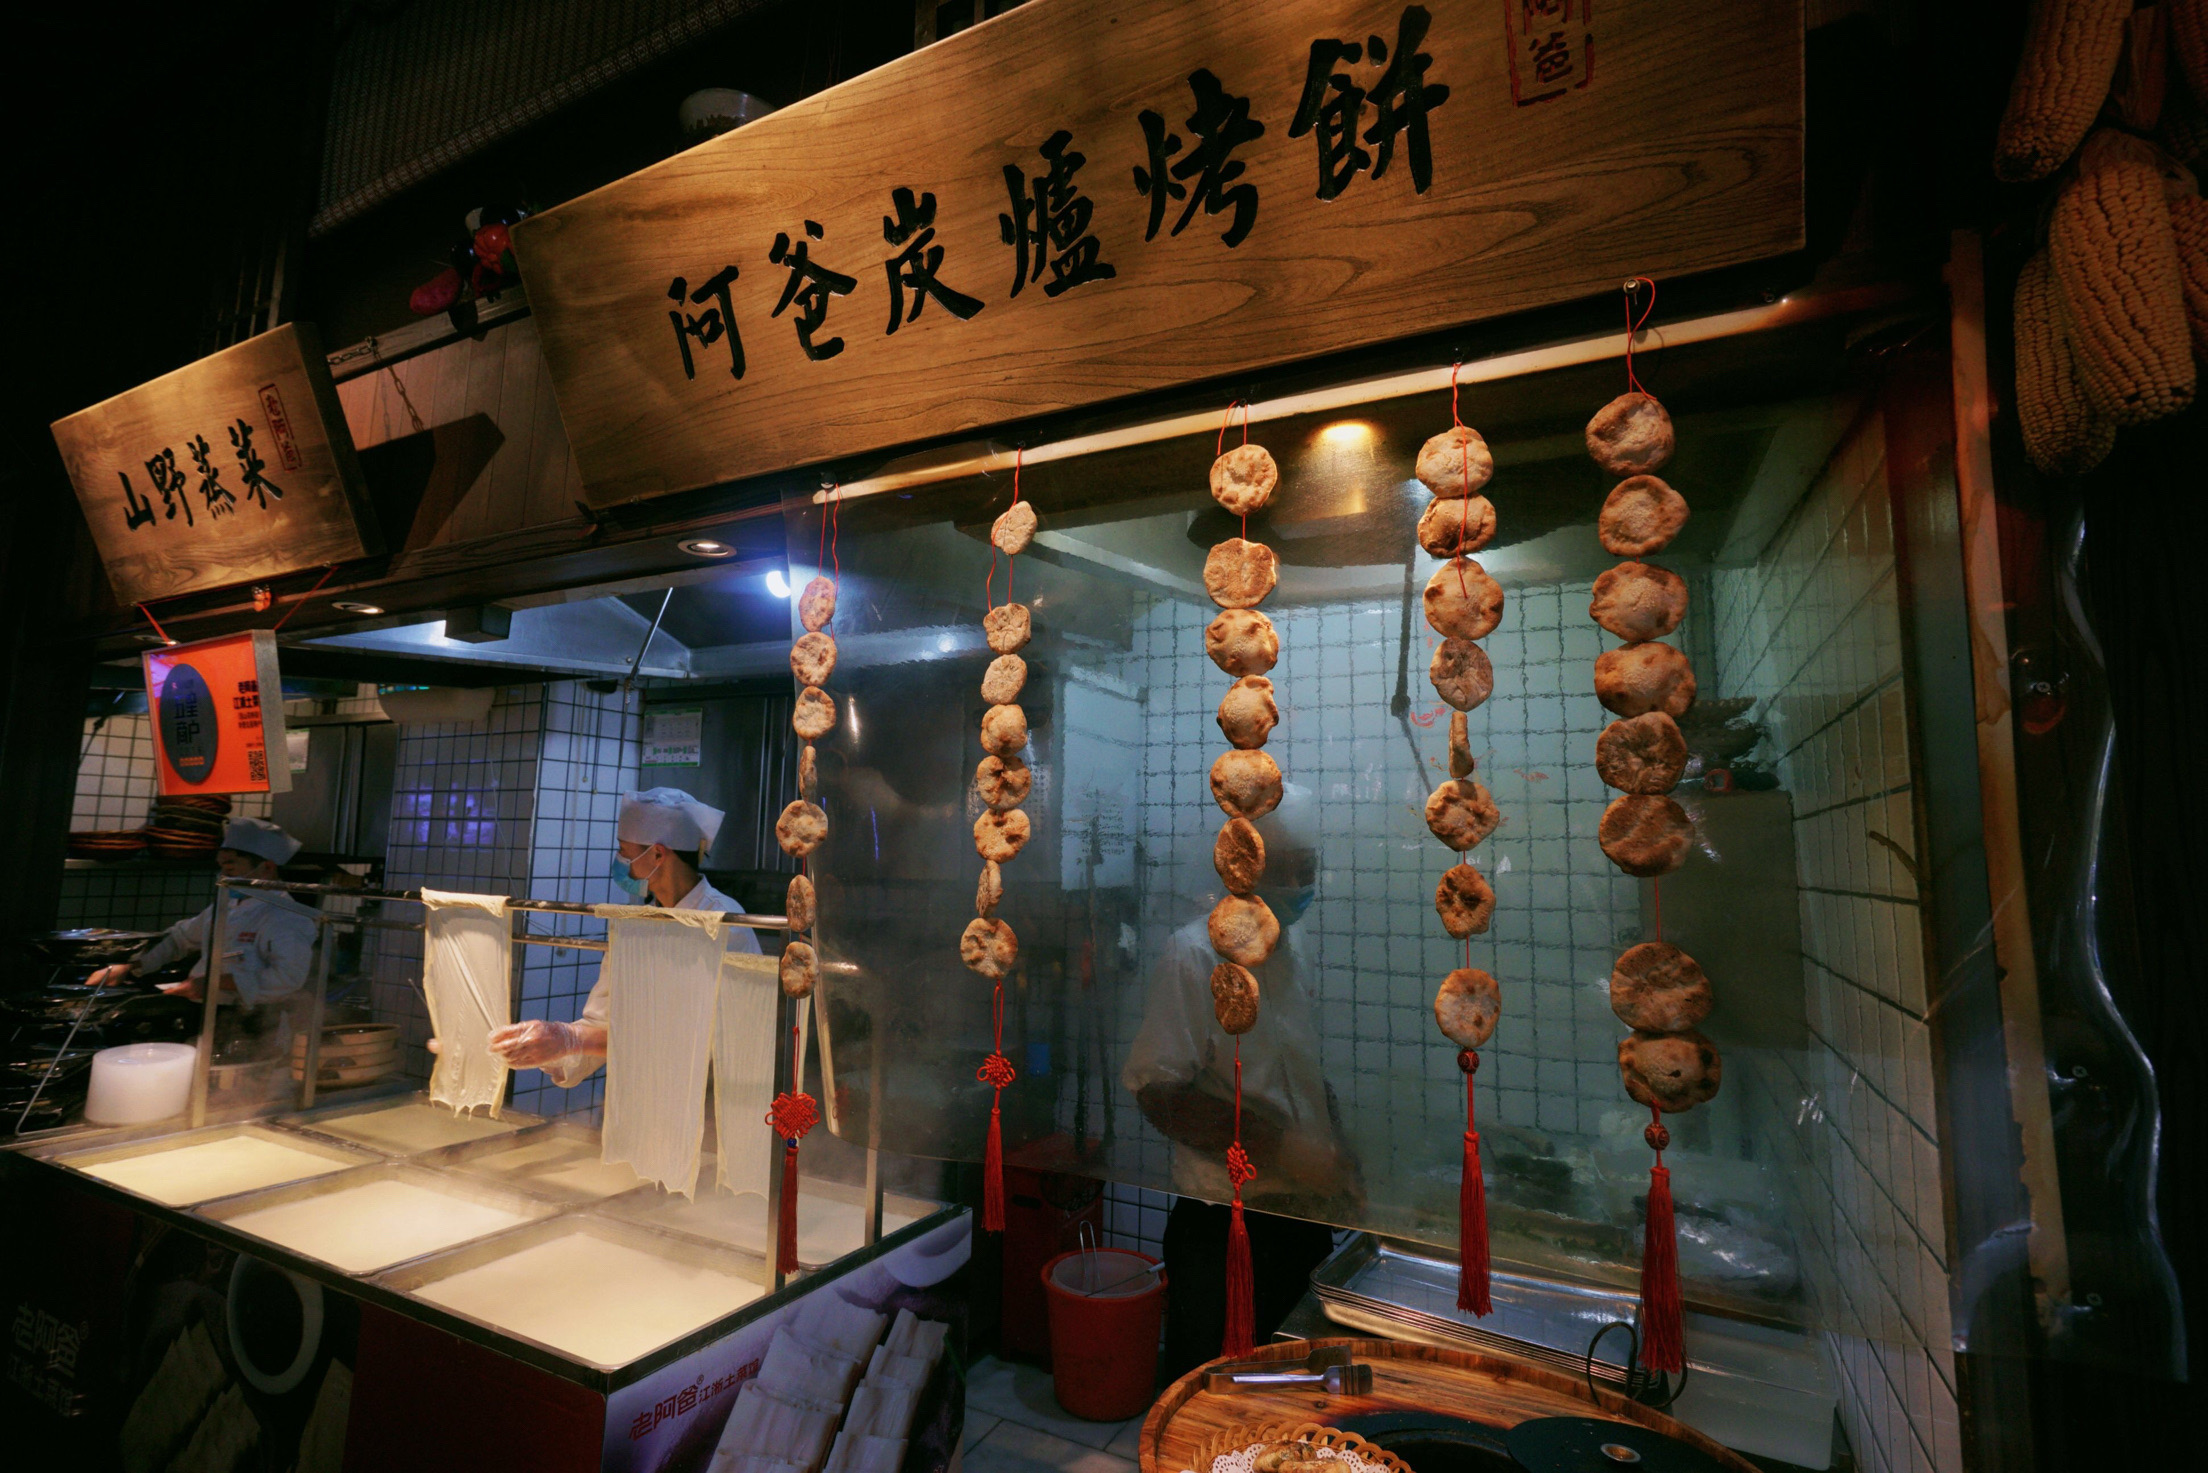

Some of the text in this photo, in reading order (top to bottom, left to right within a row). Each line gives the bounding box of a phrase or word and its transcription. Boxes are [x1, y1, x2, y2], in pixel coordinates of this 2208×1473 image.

[118, 418, 284, 532] 山野蒸菜
[629, 1384, 699, 1441] 老阿爸
